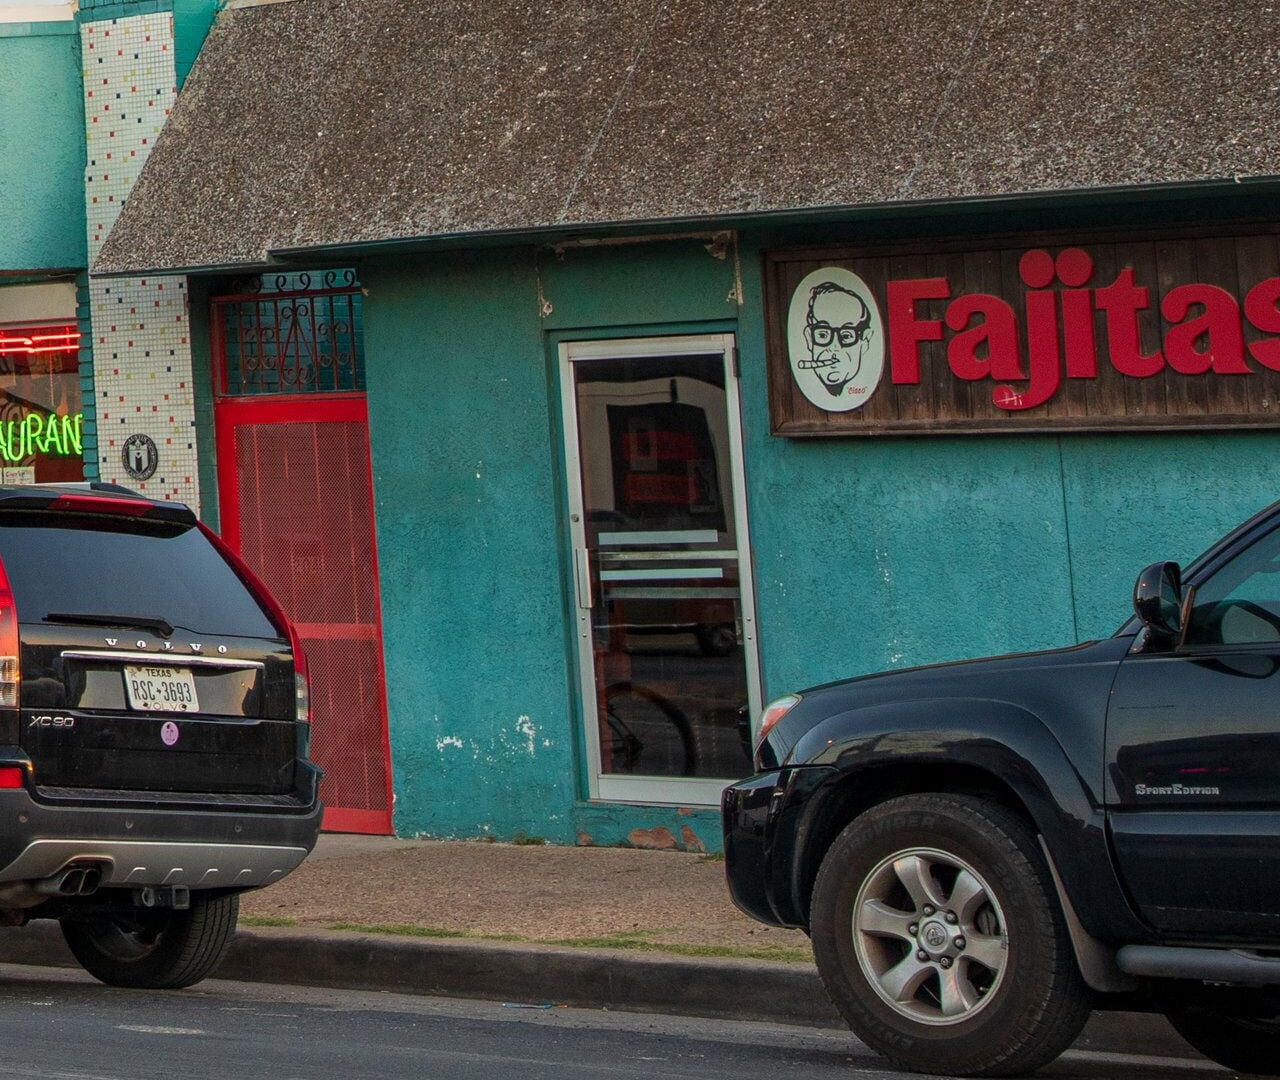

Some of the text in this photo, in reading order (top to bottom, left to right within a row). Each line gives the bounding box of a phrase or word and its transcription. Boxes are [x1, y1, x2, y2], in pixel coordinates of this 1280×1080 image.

[105, 637, 228, 654] VOLVO
[144, 668, 172, 678] TEXAS
[28, 716, 75, 727] XC90
